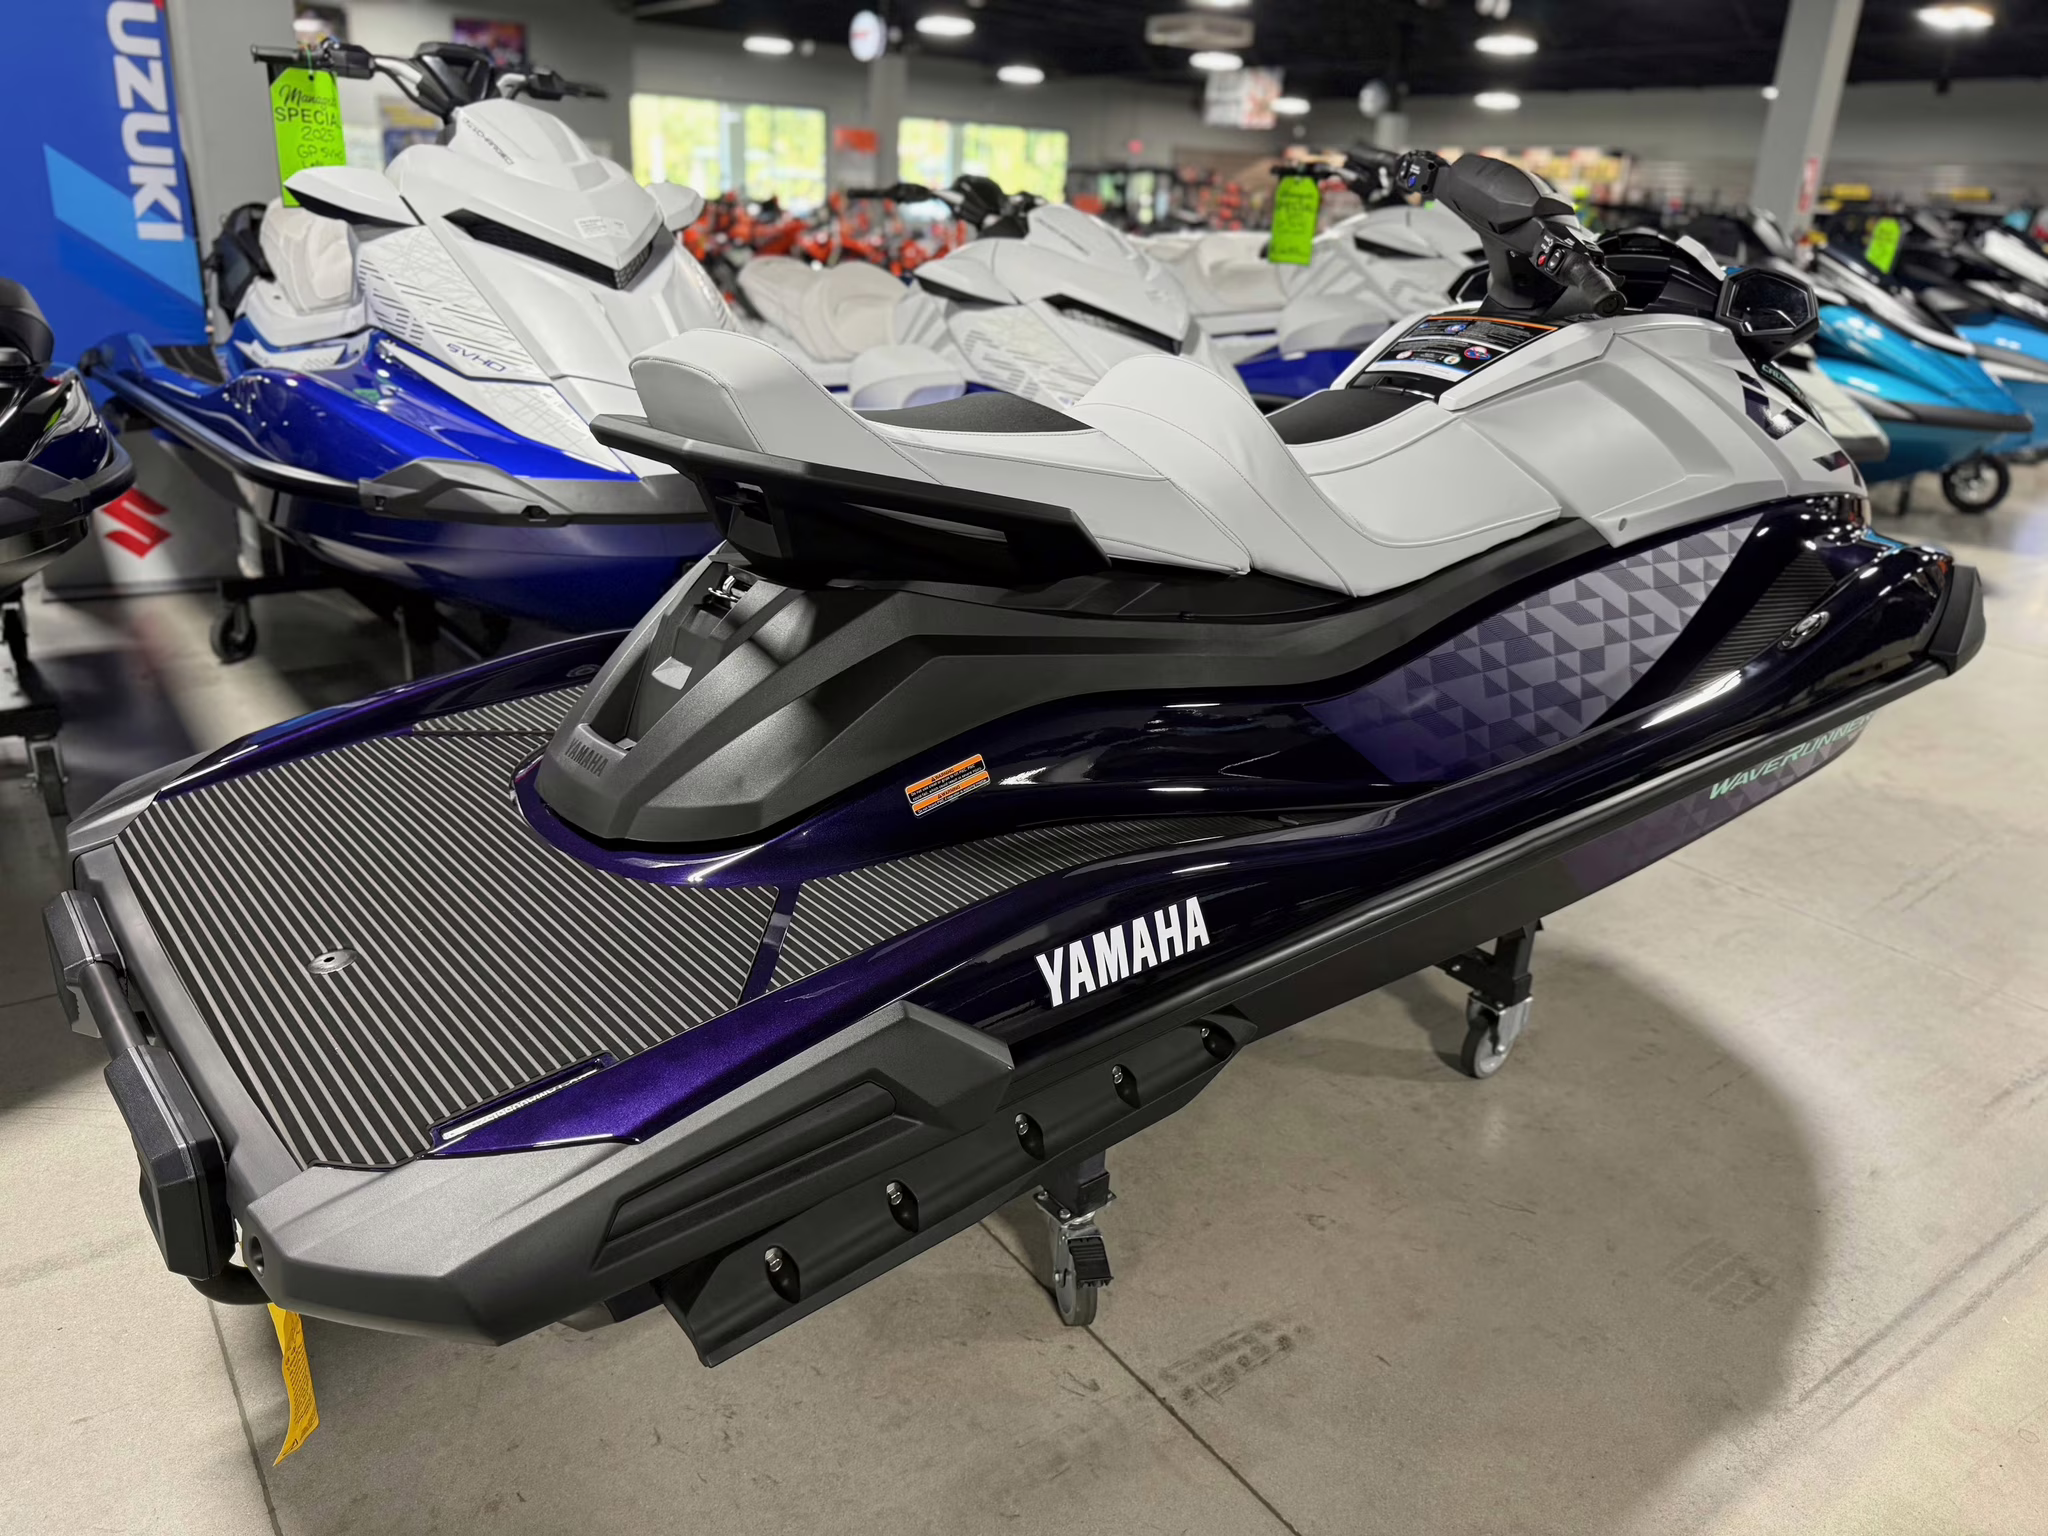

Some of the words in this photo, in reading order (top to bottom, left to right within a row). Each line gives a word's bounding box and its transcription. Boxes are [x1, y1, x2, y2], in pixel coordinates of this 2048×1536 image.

[106, 0, 184, 241] UZUKI
[301, 126, 335, 142] 2025
[447, 343, 507, 372] SVHO
[565, 738, 609, 777] YAMAHA
[1035, 896, 1210, 1008] YAMAHA
